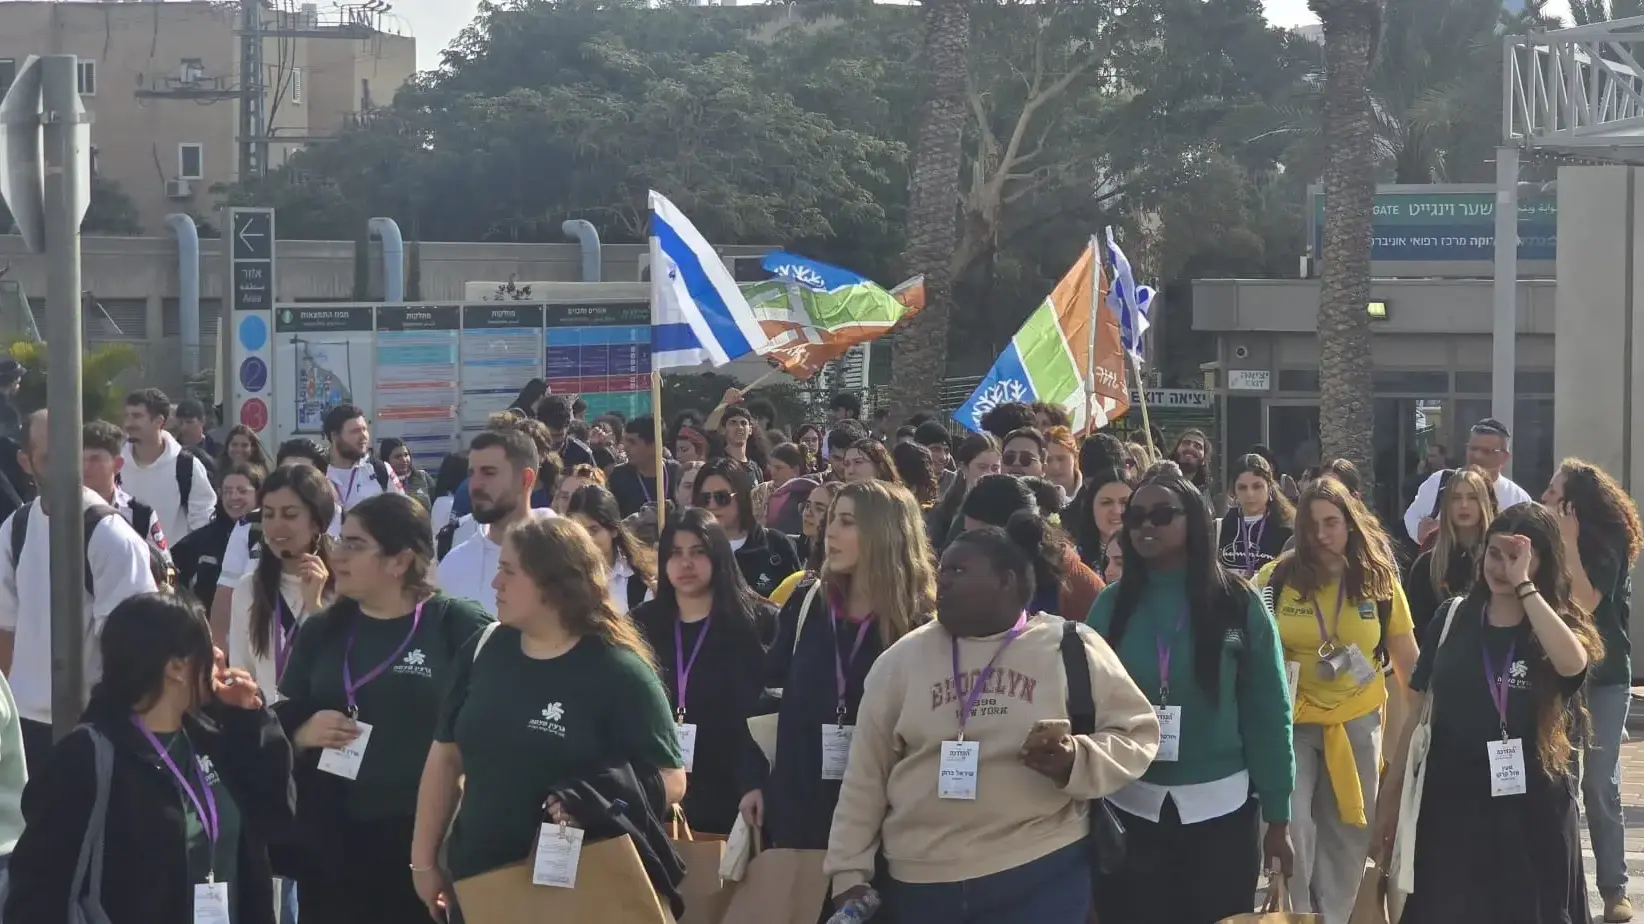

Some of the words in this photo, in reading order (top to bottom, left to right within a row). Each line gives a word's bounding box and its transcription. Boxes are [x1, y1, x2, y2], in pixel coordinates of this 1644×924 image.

[1373, 205, 1399, 215] GATE
[1409, 203, 1454, 216] וינגייט
[1458, 203, 1493, 216] שער
[1410, 237, 1438, 246] רפואי
[1441, 237, 1466, 246] מרכז
[246, 359, 262, 389] 2
[1131, 391, 1165, 404] EXIT
[1169, 392, 1206, 404] יציאה
[247, 404, 262, 428] 3
[981, 706, 1008, 716] YORK
